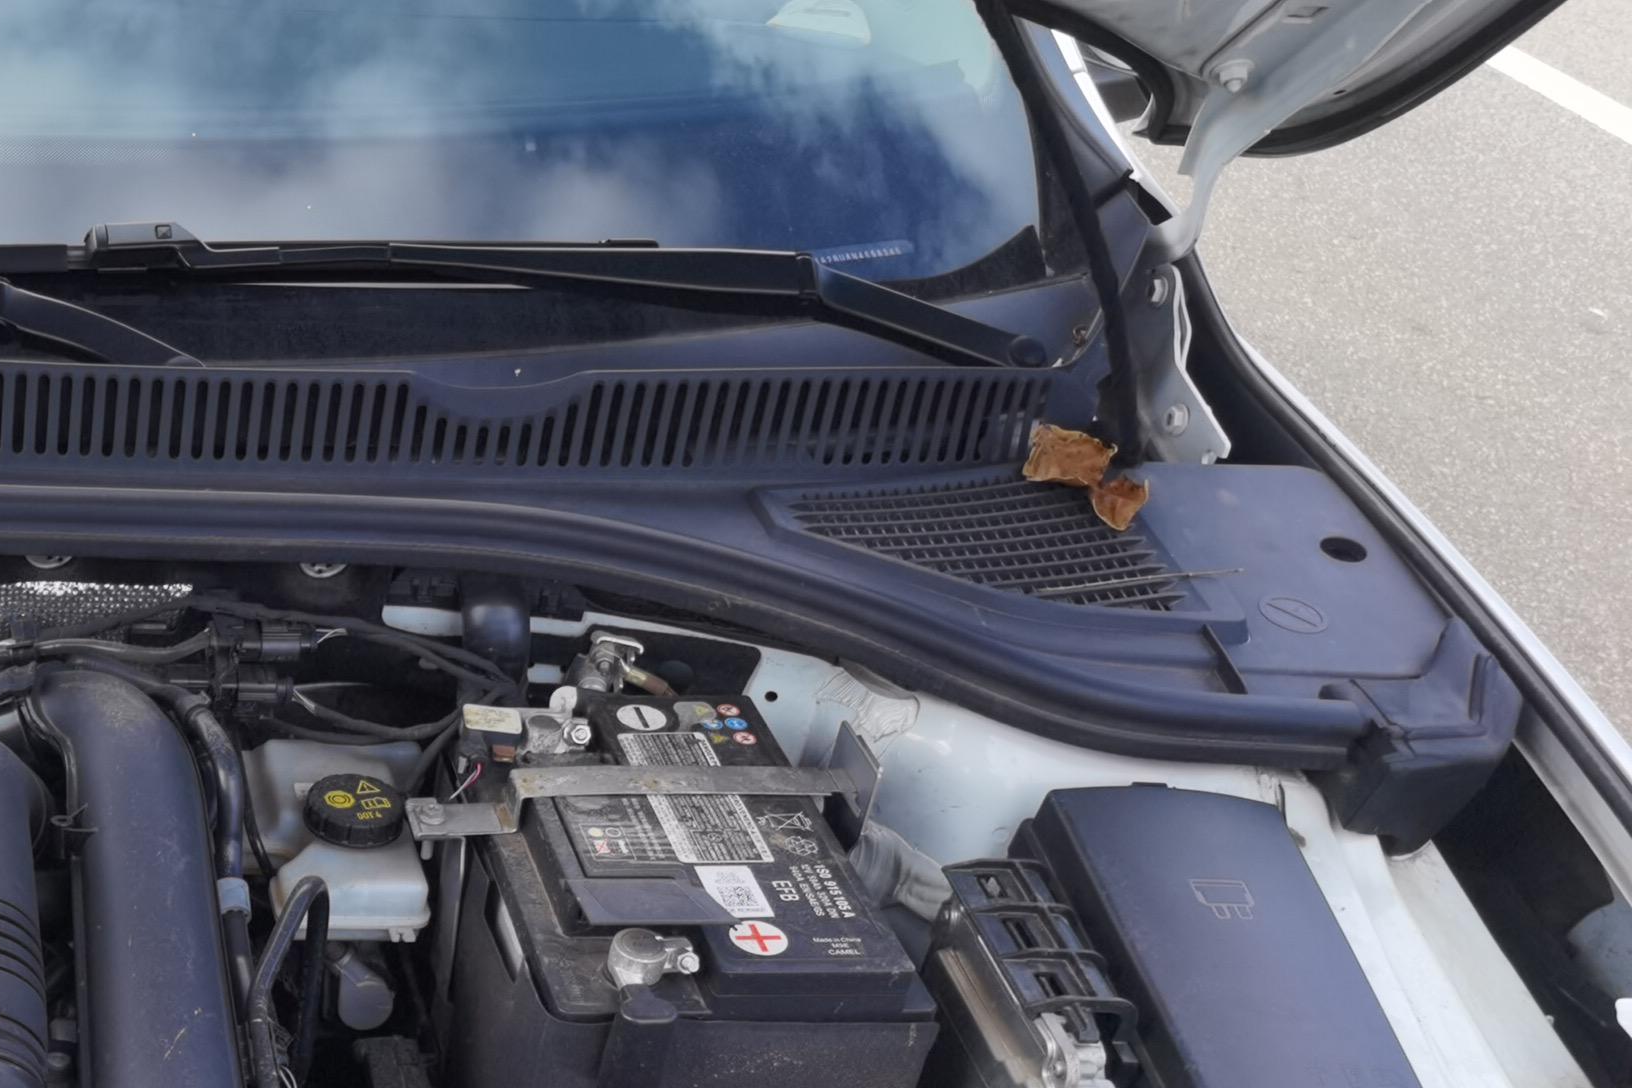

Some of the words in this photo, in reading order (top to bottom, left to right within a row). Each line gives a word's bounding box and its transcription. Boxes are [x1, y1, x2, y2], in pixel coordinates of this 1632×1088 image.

[772, 880, 800, 901] EFB
[823, 881, 842, 895] 915
[833, 896, 852, 910] 105
